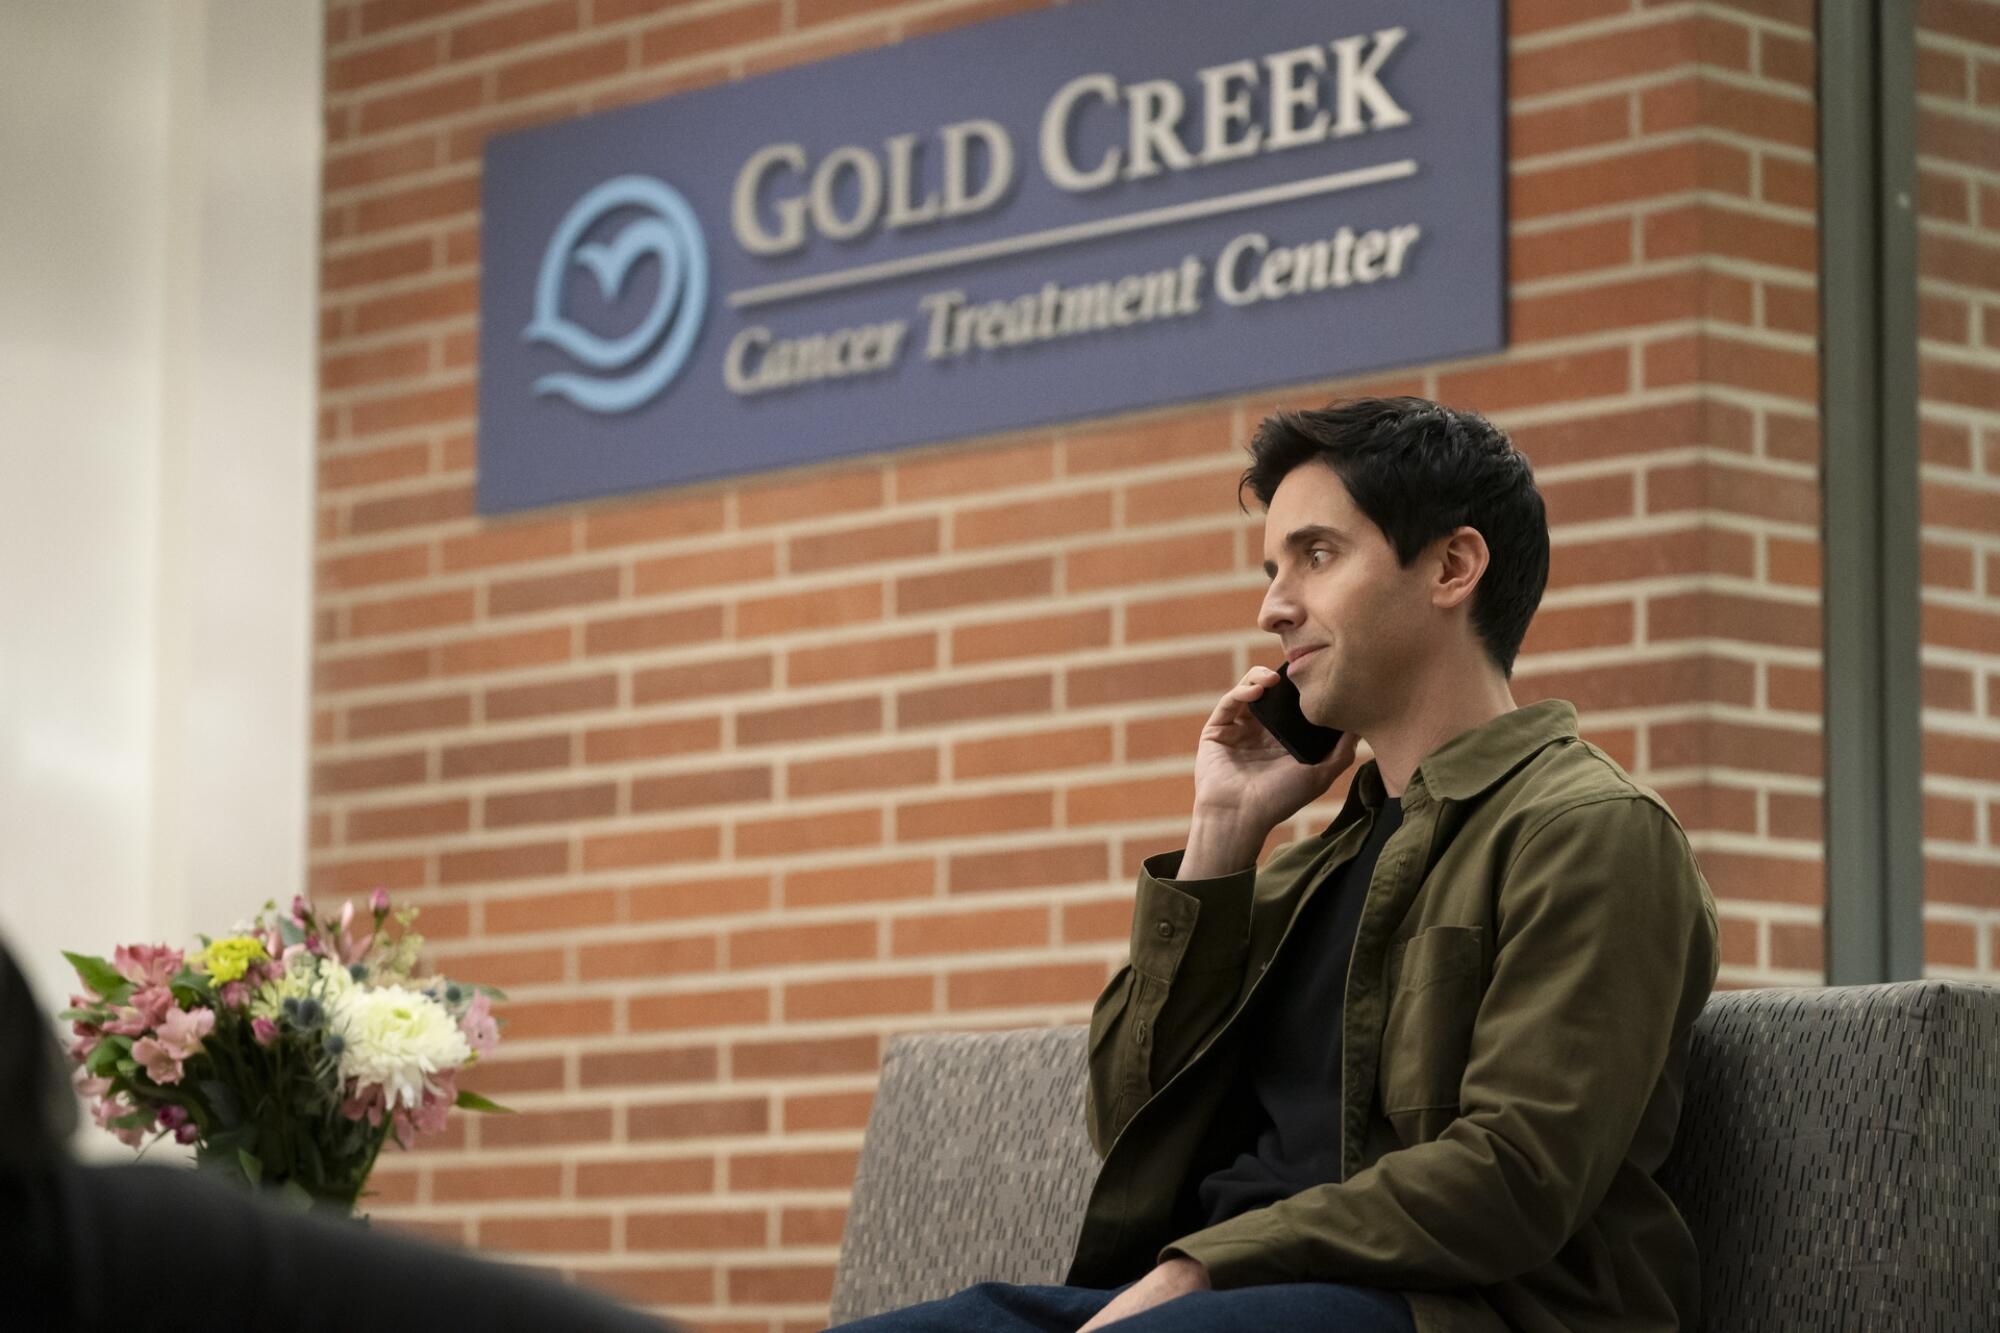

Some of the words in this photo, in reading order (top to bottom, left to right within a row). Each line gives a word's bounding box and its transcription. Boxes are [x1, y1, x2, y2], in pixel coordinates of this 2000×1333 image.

[732, 119, 1013, 255] GOLD
[1039, 27, 1411, 191] CREEK
[724, 319, 906, 394] Cancer
[920, 256, 1204, 359] Treatment
[1214, 223, 1421, 306] Center
